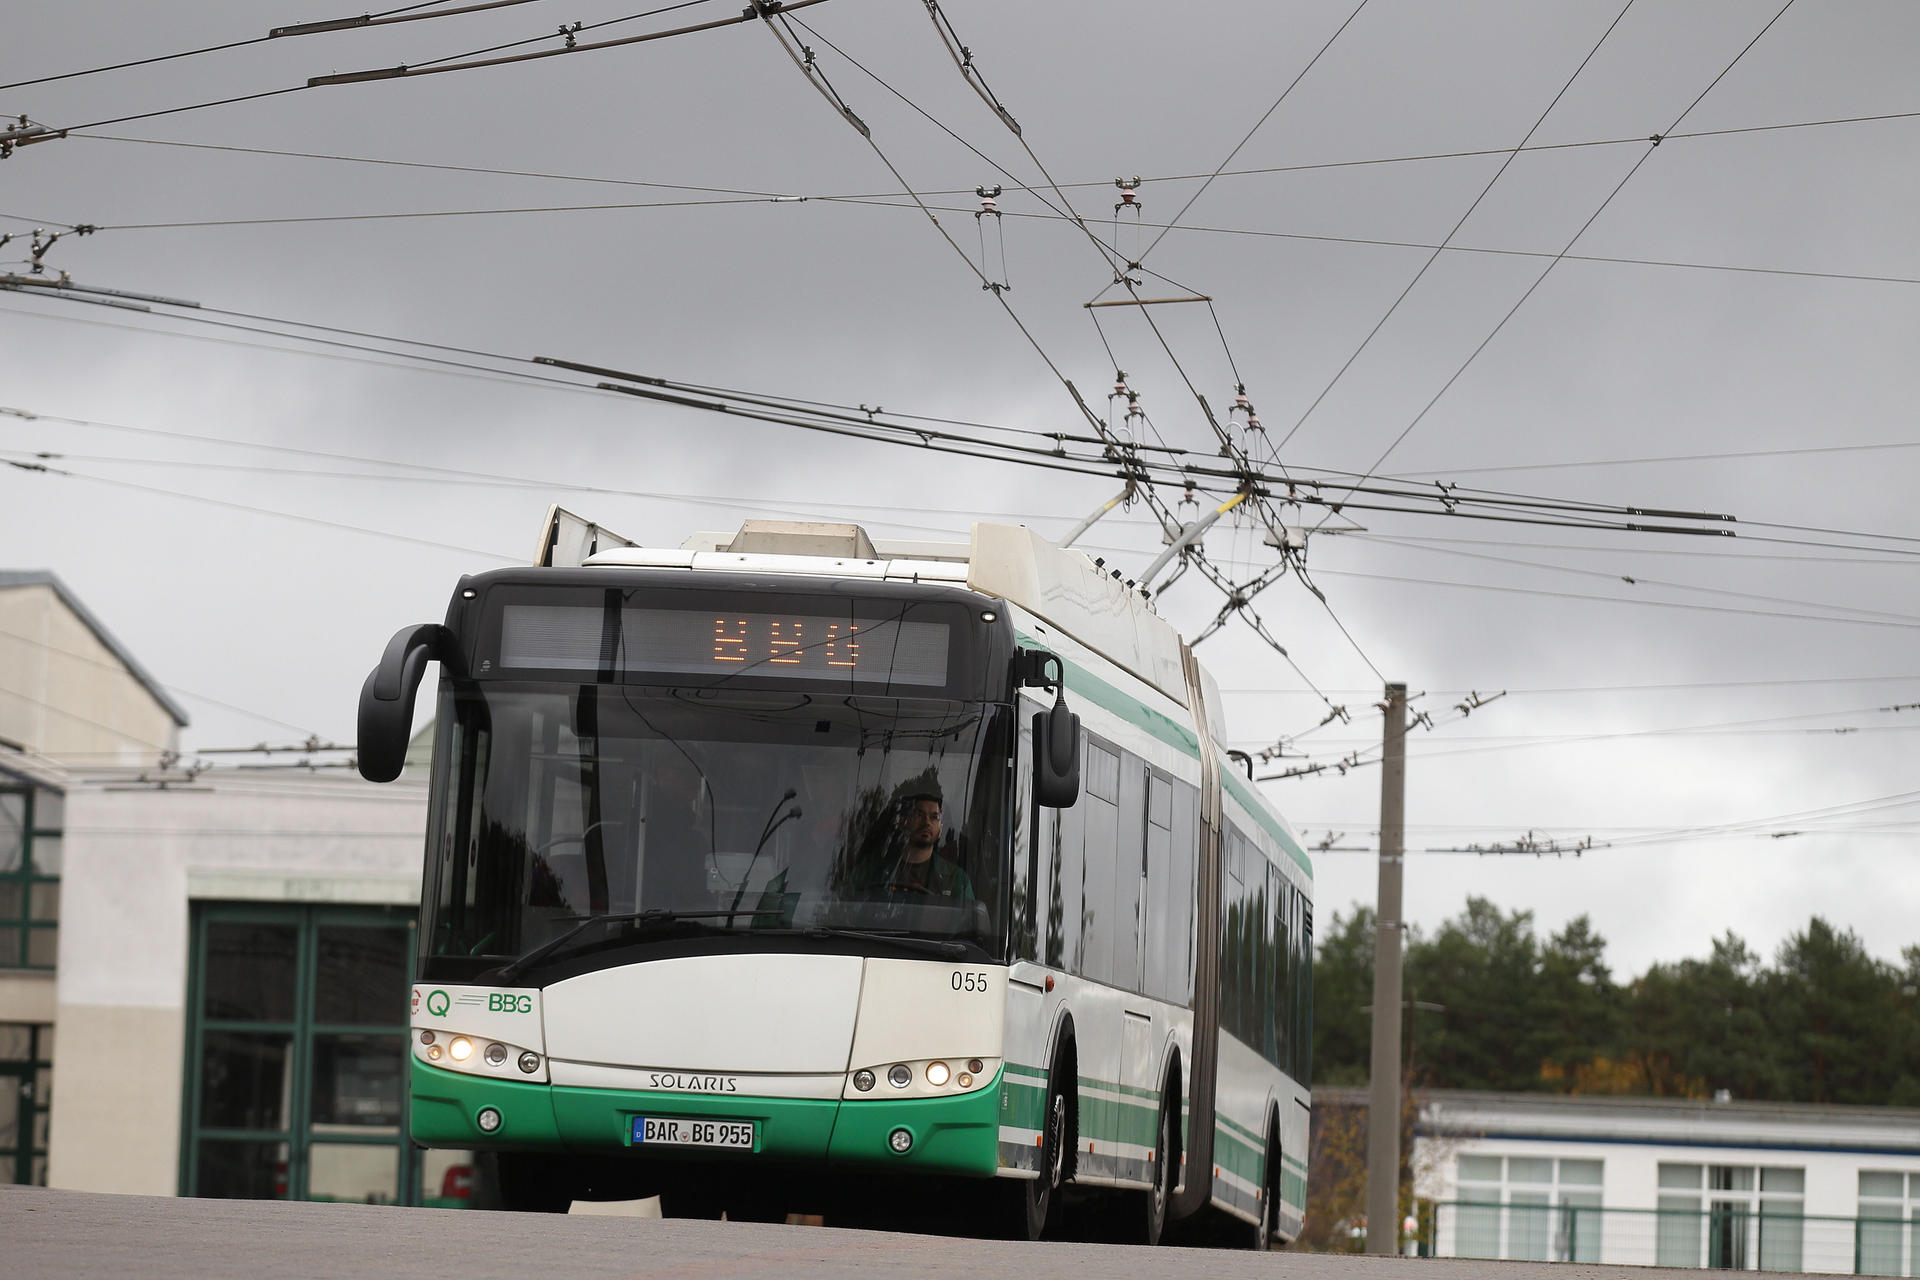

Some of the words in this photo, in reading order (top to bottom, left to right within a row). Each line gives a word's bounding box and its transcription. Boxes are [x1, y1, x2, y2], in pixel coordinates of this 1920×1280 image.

[951, 971, 988, 992] 055
[488, 993, 532, 1014] BBG
[649, 1073, 737, 1092] SOLARIS
[645, 1120, 679, 1142] BAR
[692, 1123, 715, 1144] BG
[719, 1125, 752, 1145] 955
